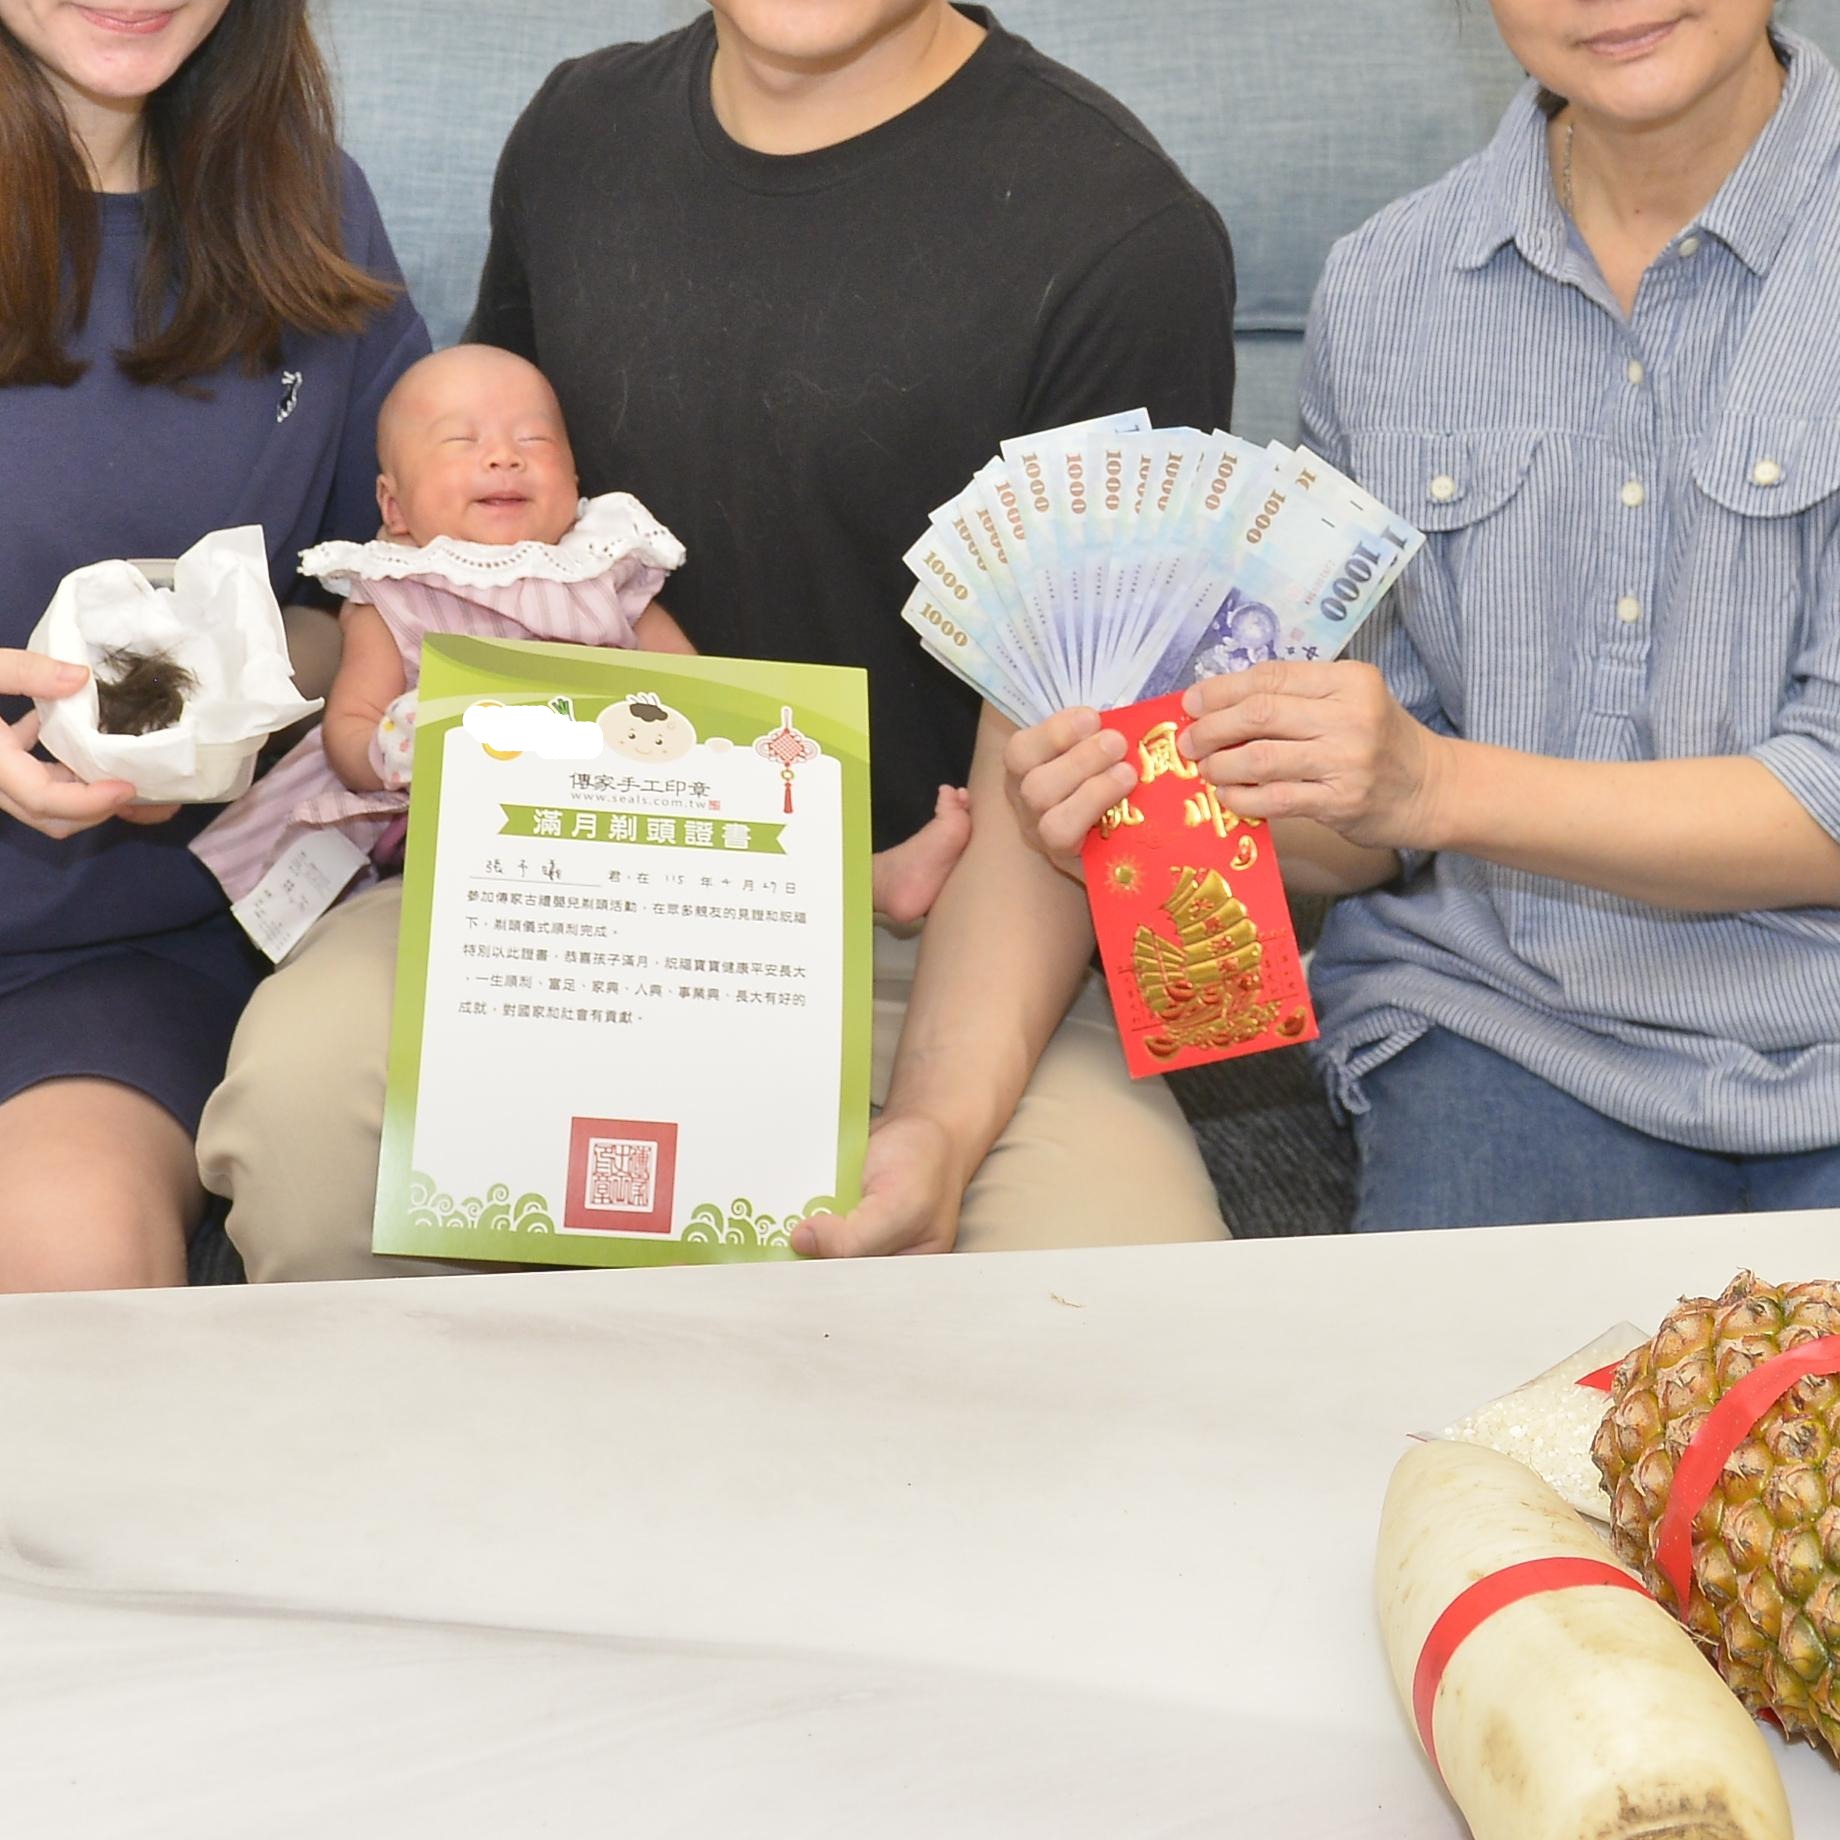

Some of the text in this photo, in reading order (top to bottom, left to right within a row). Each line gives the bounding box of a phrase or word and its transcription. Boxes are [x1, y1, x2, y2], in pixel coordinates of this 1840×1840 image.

[1022, 452, 1049, 512] 1000
[1066, 453, 1087, 514] 1000
[1105, 450, 1122, 510] 1000
[1205, 451, 1238, 510] 1000
[995, 481, 1026, 540] 1000
[1246, 490, 1286, 544] 1000
[923, 551, 968, 600] 1000
[1320, 539, 1382, 622] 1000
[920, 603, 968, 646] 1000
[569, 772, 711, 798] 傳家手工印章
[571, 792, 707, 809] www.seals.com.tw
[533, 809, 751, 849] 滿月剃頭證書
[743, 879, 754, 891] 月
[785, 882, 796, 894] 日
